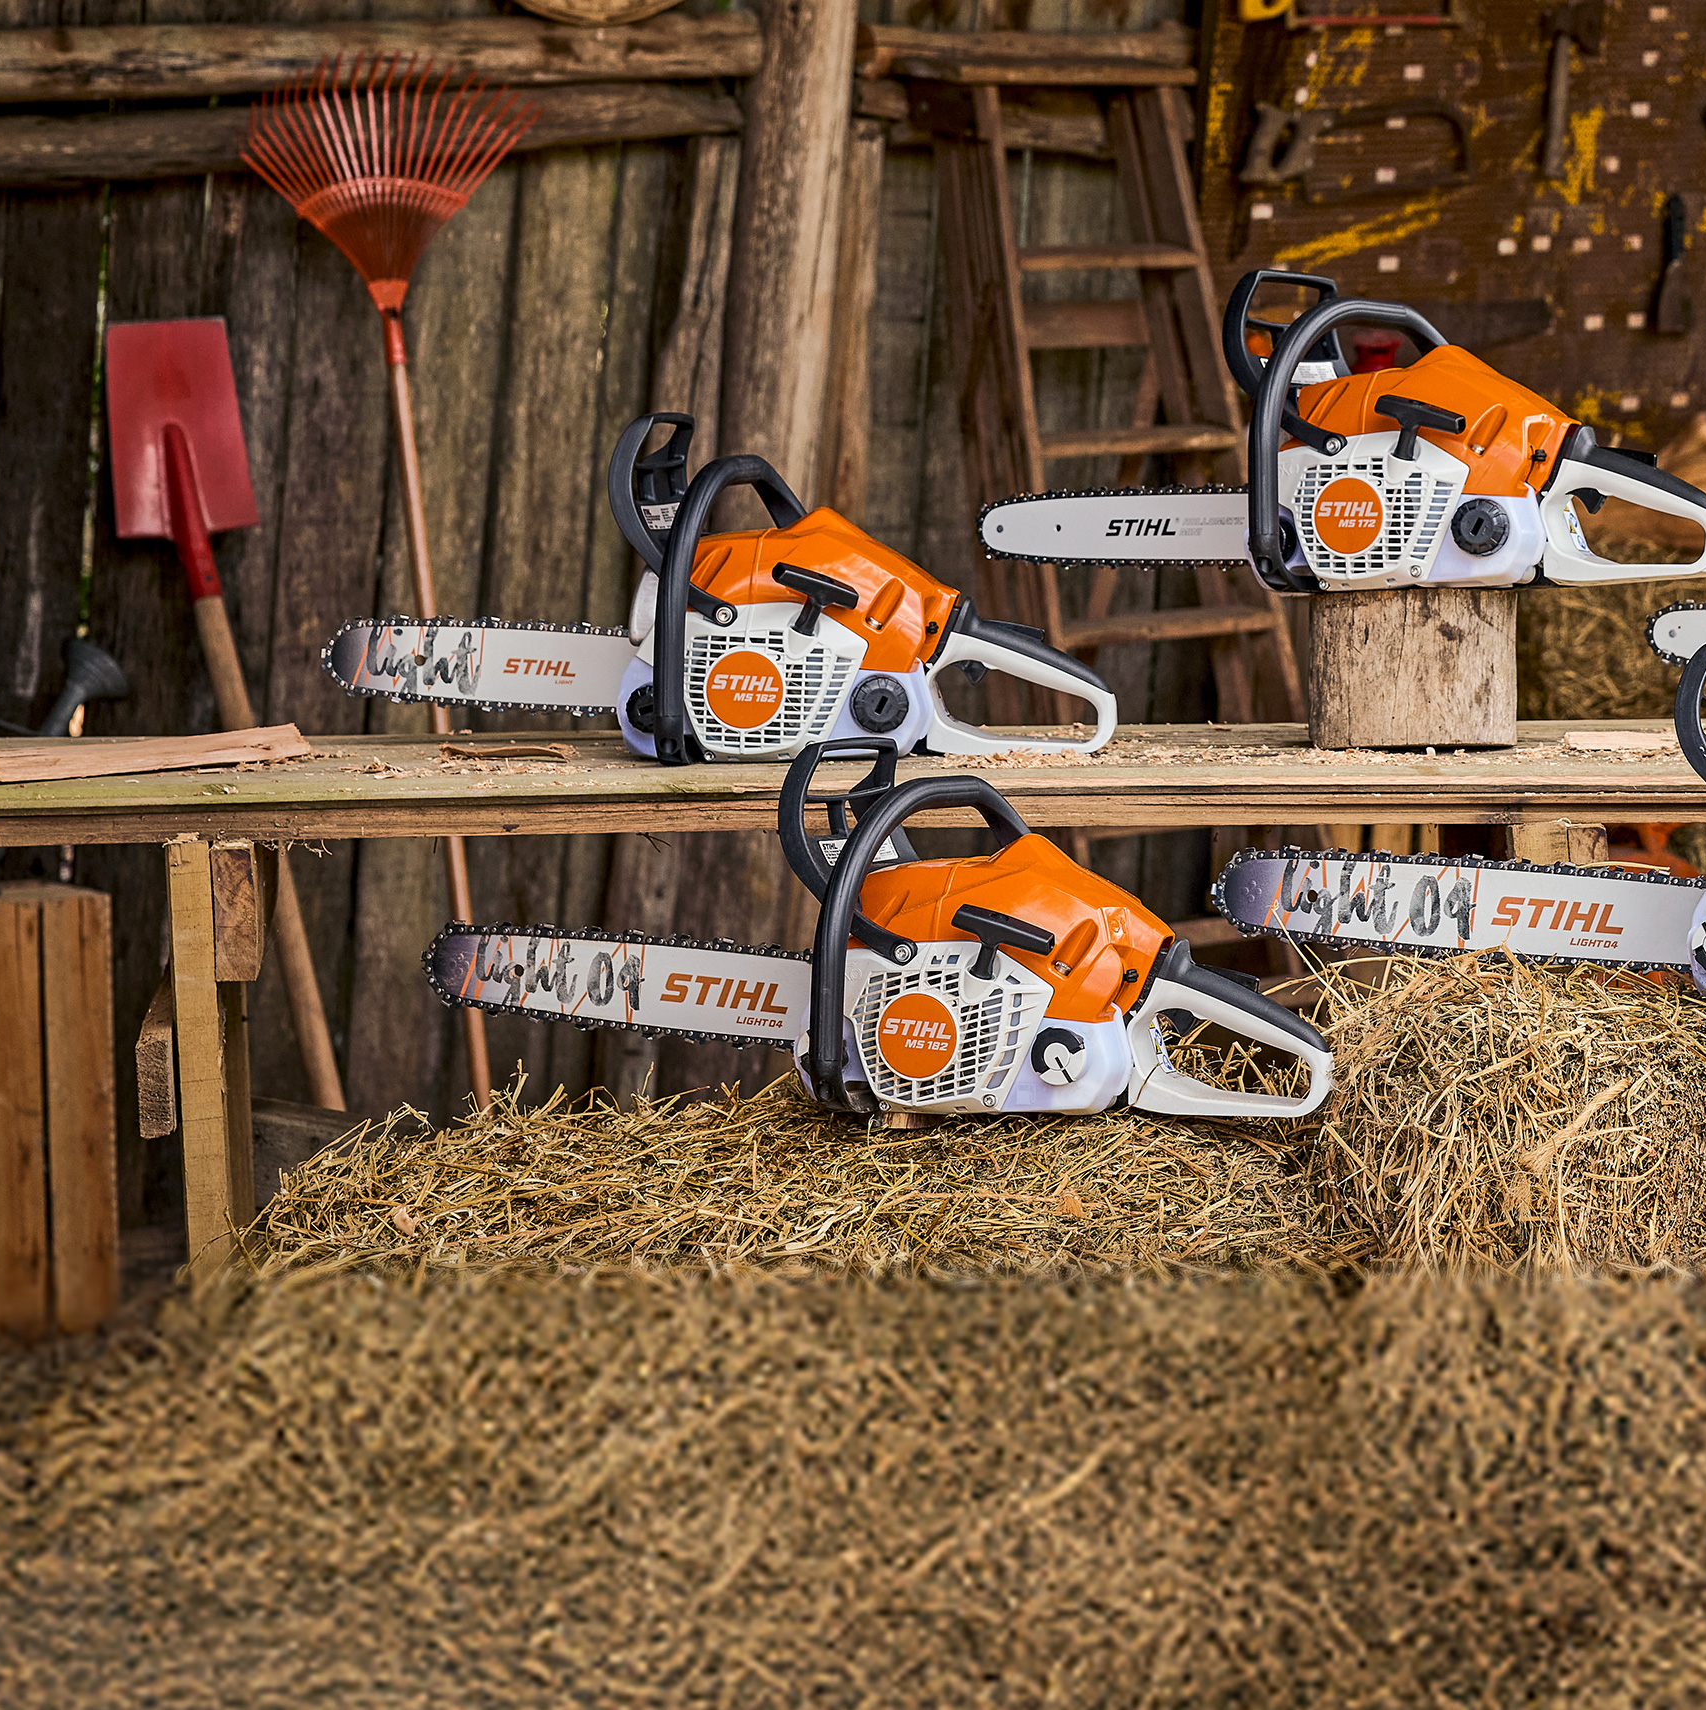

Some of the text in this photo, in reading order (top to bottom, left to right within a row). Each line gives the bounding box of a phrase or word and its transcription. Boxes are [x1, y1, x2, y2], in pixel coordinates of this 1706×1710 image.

[1317, 501, 1379, 517] STIHL
[1105, 518, 1176, 537] STIHL
[1338, 519, 1376, 528] MS 172
[503, 658, 576, 678] STIHL
[711, 673, 779, 692] STIHL
[733, 692, 754, 702] MS
[1490, 896, 1624, 935] STIHL
[659, 972, 789, 1015] STIHL
[882, 1017, 952, 1040] STIHL
[904, 1038, 949, 1052] MS 182
